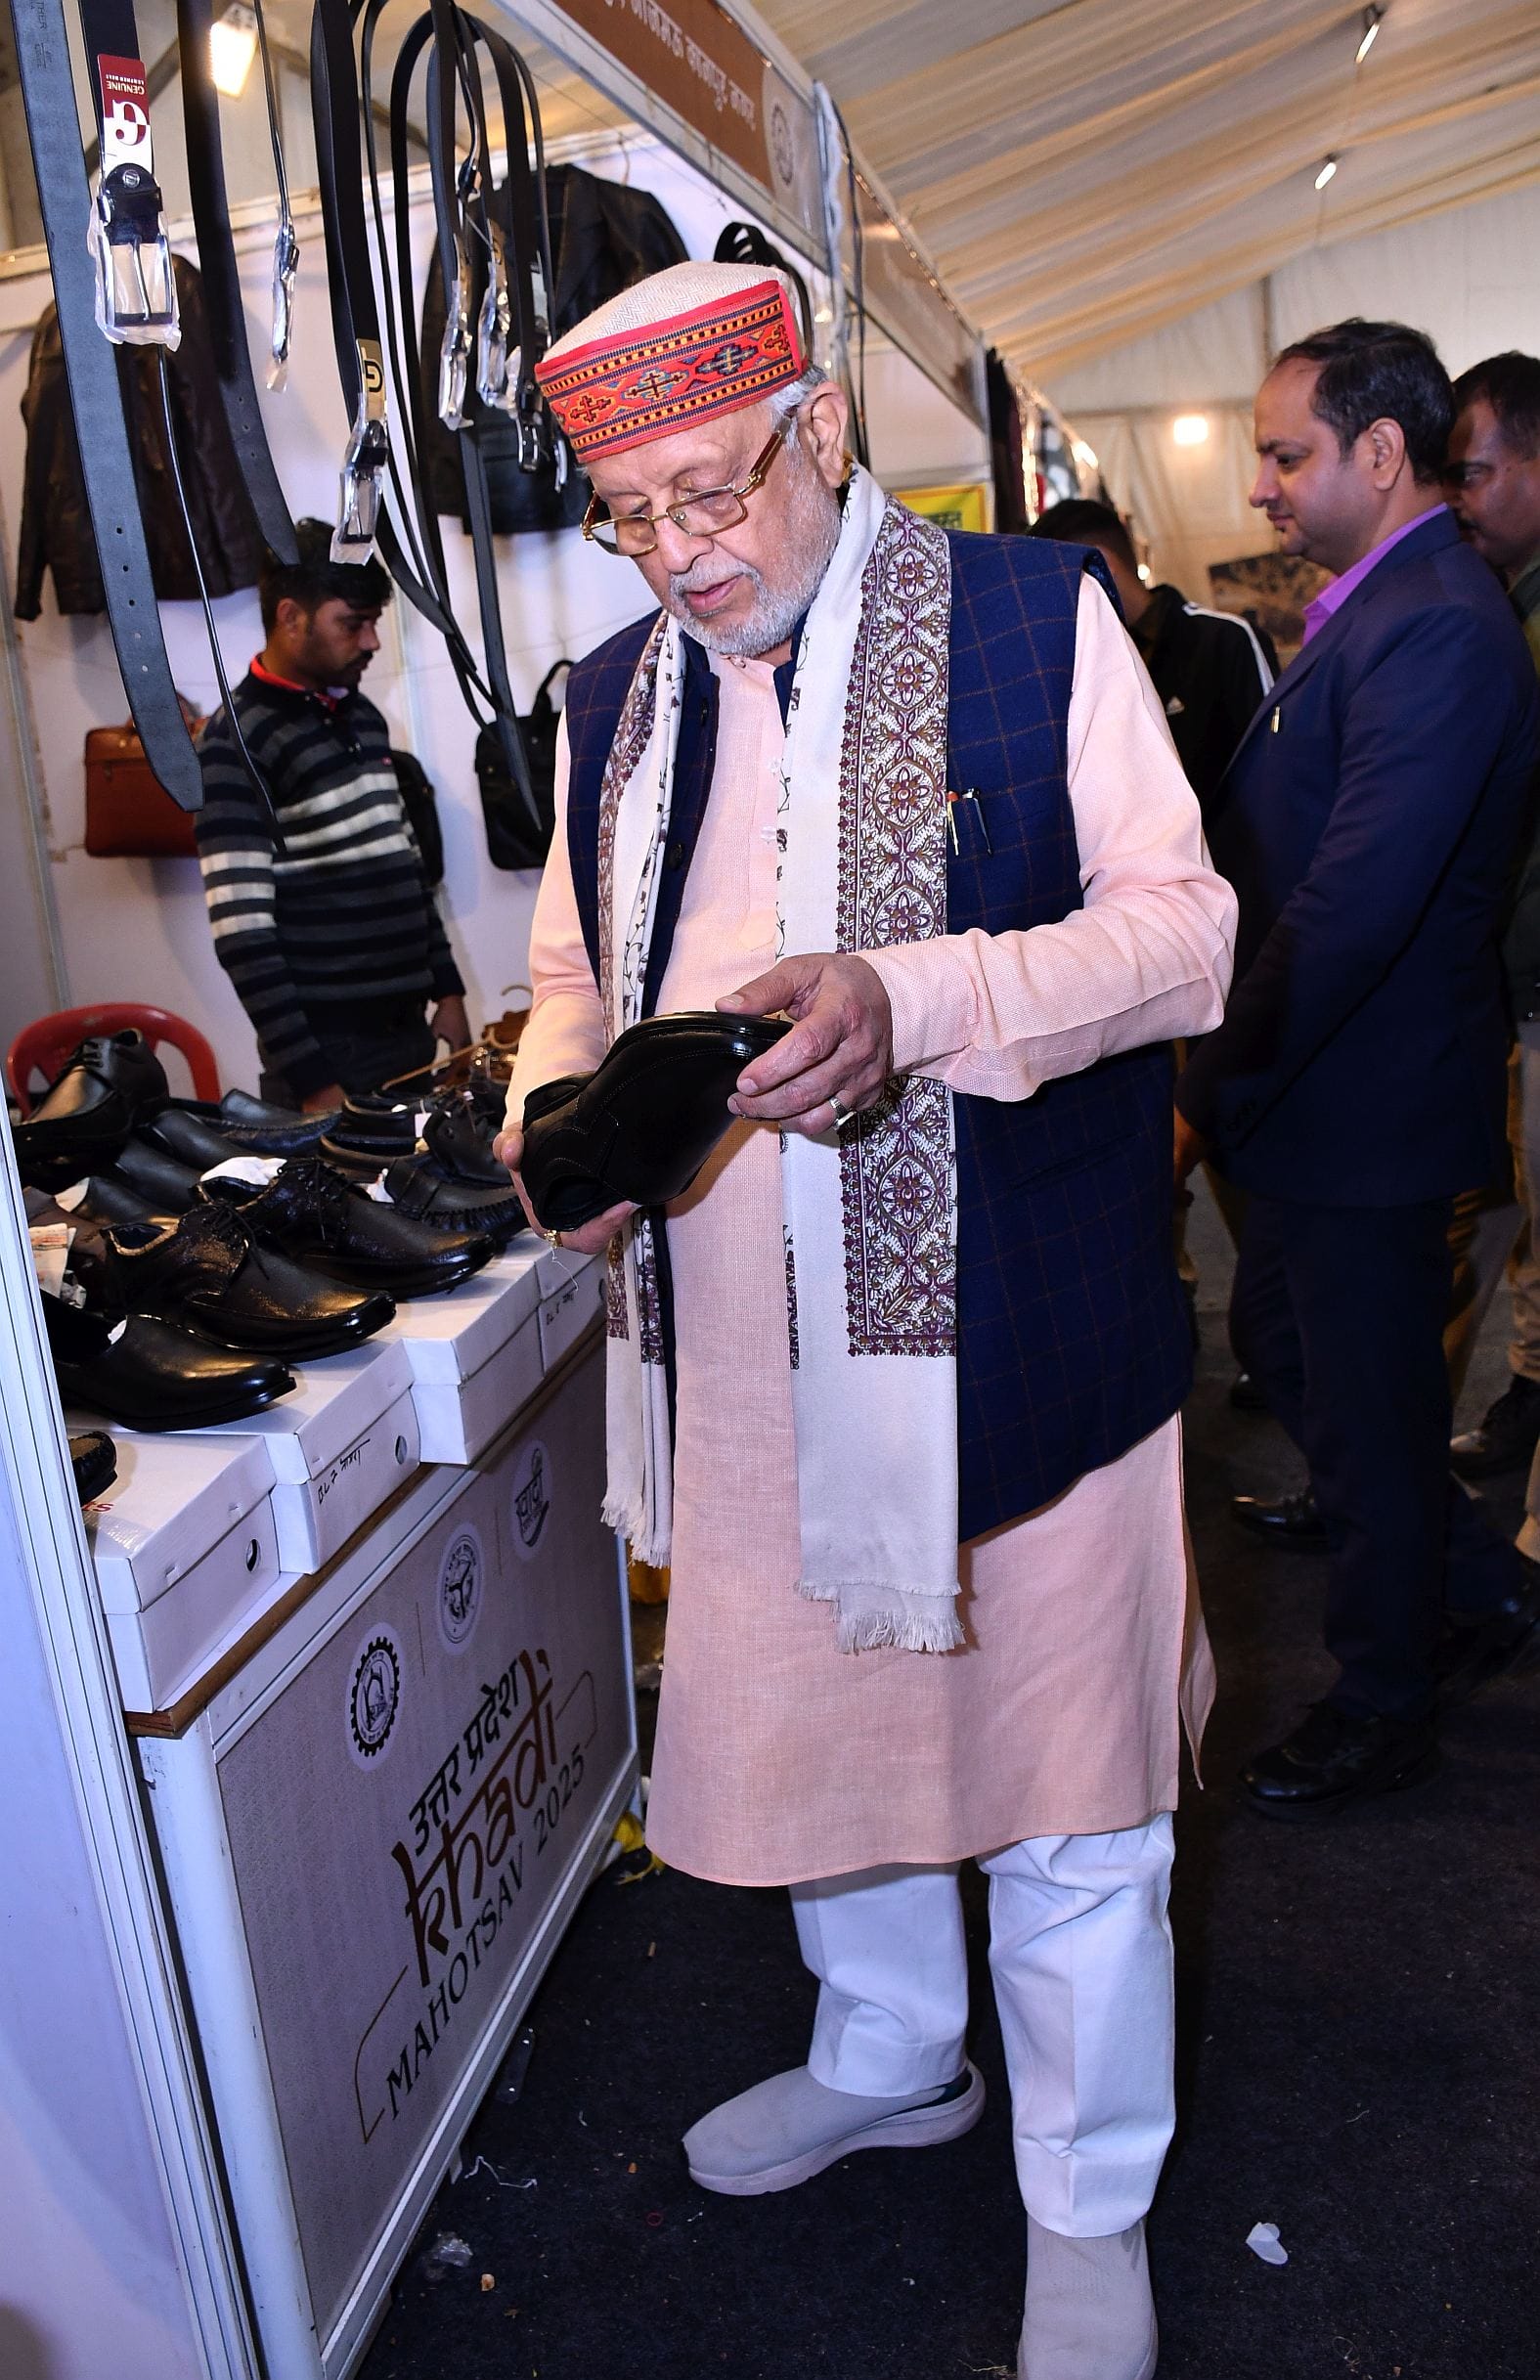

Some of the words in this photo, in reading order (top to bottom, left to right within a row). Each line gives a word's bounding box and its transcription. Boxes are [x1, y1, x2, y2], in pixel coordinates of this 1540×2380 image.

[107, 80, 146, 96] GENUINE
[463, 1658, 519, 1777] प्रदेश
[385, 1840, 524, 2121] MAHOTSAV
[533, 1742, 585, 1846] 2025
